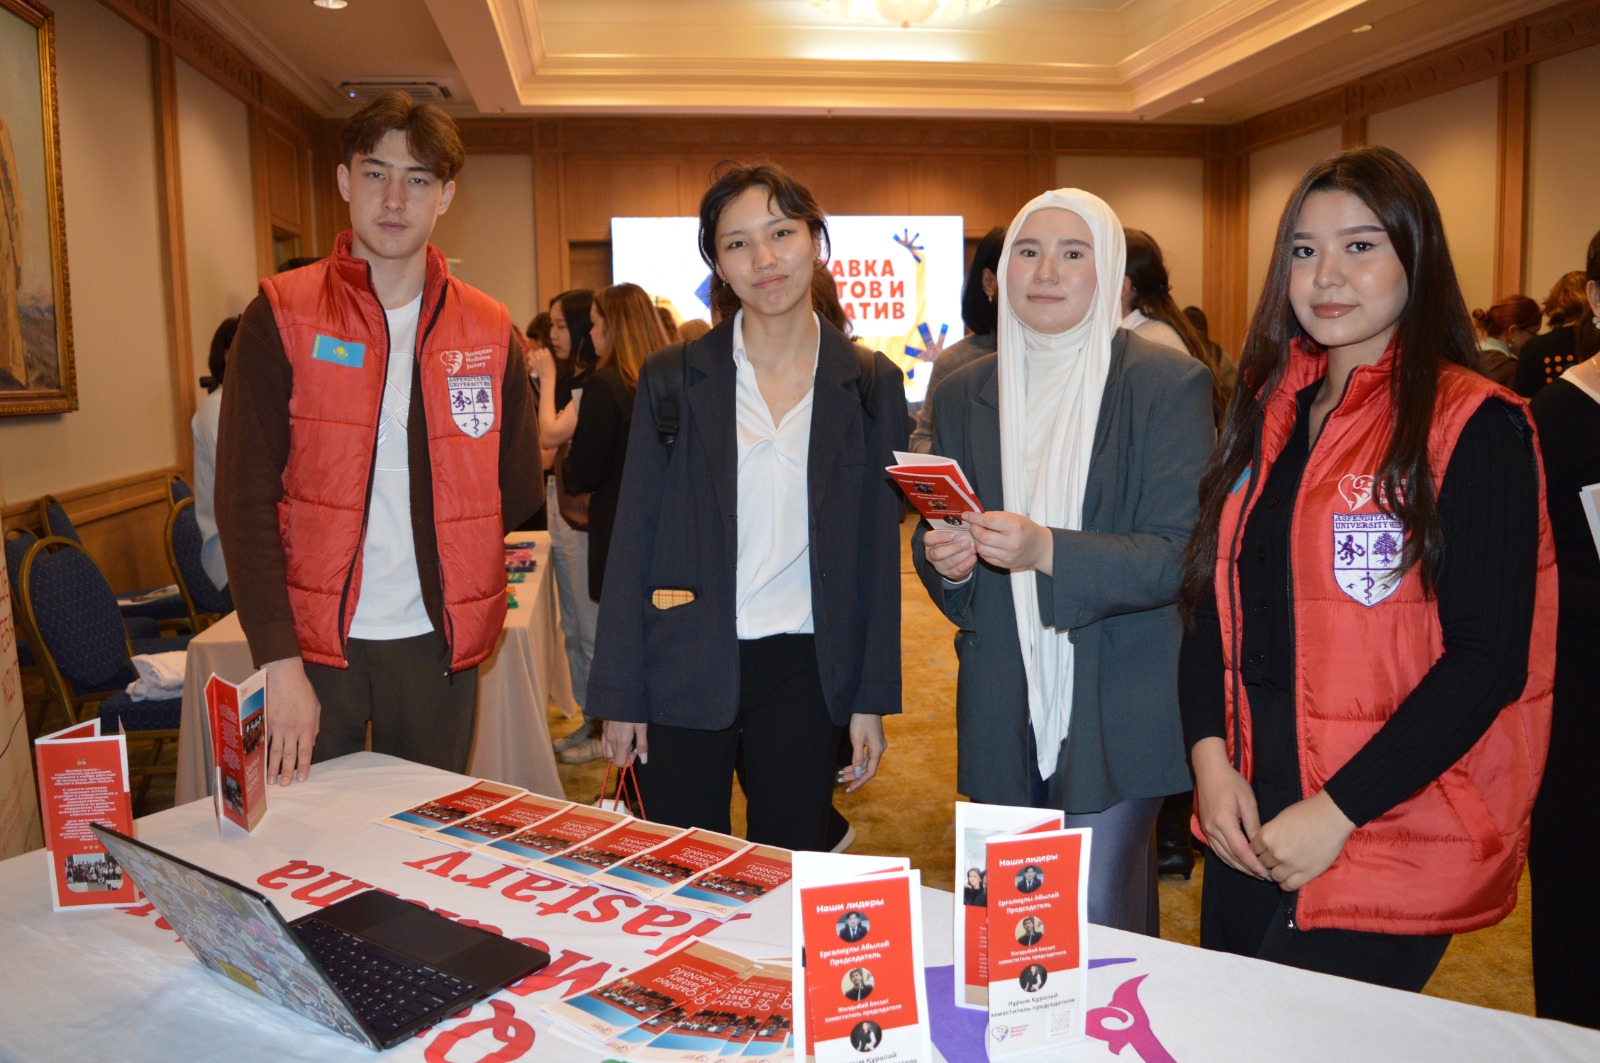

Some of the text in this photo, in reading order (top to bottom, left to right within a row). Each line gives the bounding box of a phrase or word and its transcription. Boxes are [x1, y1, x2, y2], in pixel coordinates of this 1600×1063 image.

[830, 259, 895, 277] АВКА
[836, 280, 904, 298] ТОВ И
[844, 301, 905, 320] АТИВ
[998, 853, 1059, 867] Наши лидеры
[1034, 891, 1060, 901] Абылай
[816, 898, 885, 914] Наши лидеры
[1006, 902, 1052, 915] Председатель
[860, 939, 890, 951] Абылай
[829, 951, 882, 966] Председатель
[666, 973, 705, 992] Jastary
[669, 966, 716, 987] KazNMU
[652, 977, 697, 996] QazMed
[1032, 997, 1075, 1011] председателя
[824, 1003, 902, 1023] заместитель председателя
